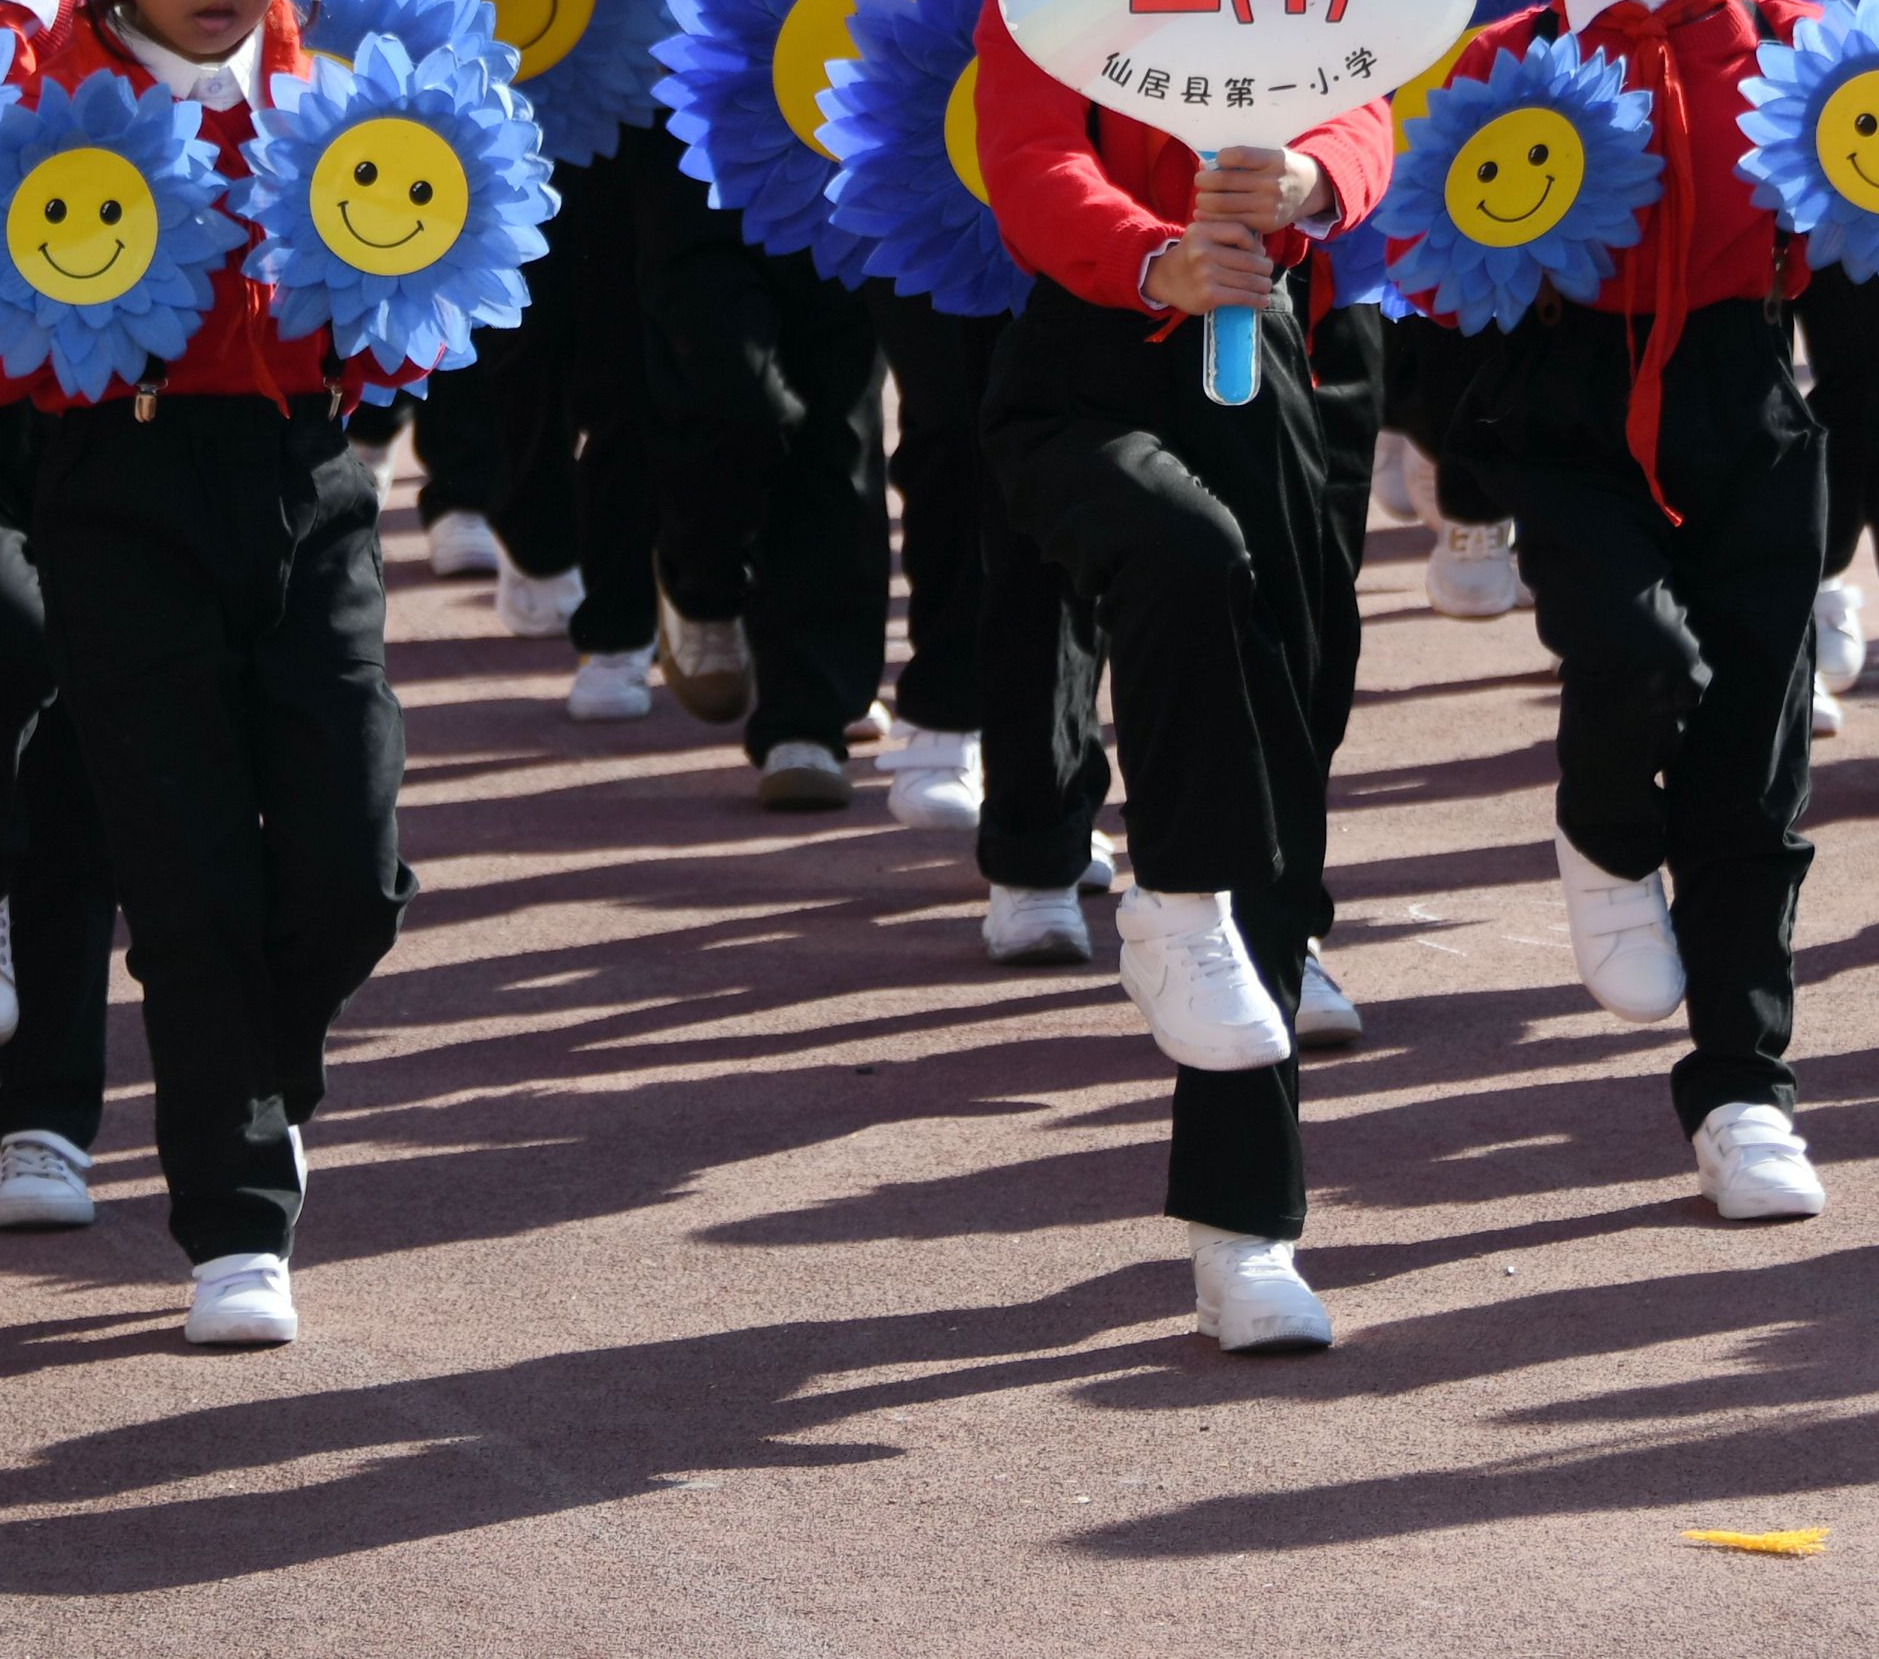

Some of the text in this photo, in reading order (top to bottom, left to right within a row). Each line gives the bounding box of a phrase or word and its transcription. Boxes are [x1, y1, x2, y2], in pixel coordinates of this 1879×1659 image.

[1101, 46, 1378, 109] 仙居县第一小学
